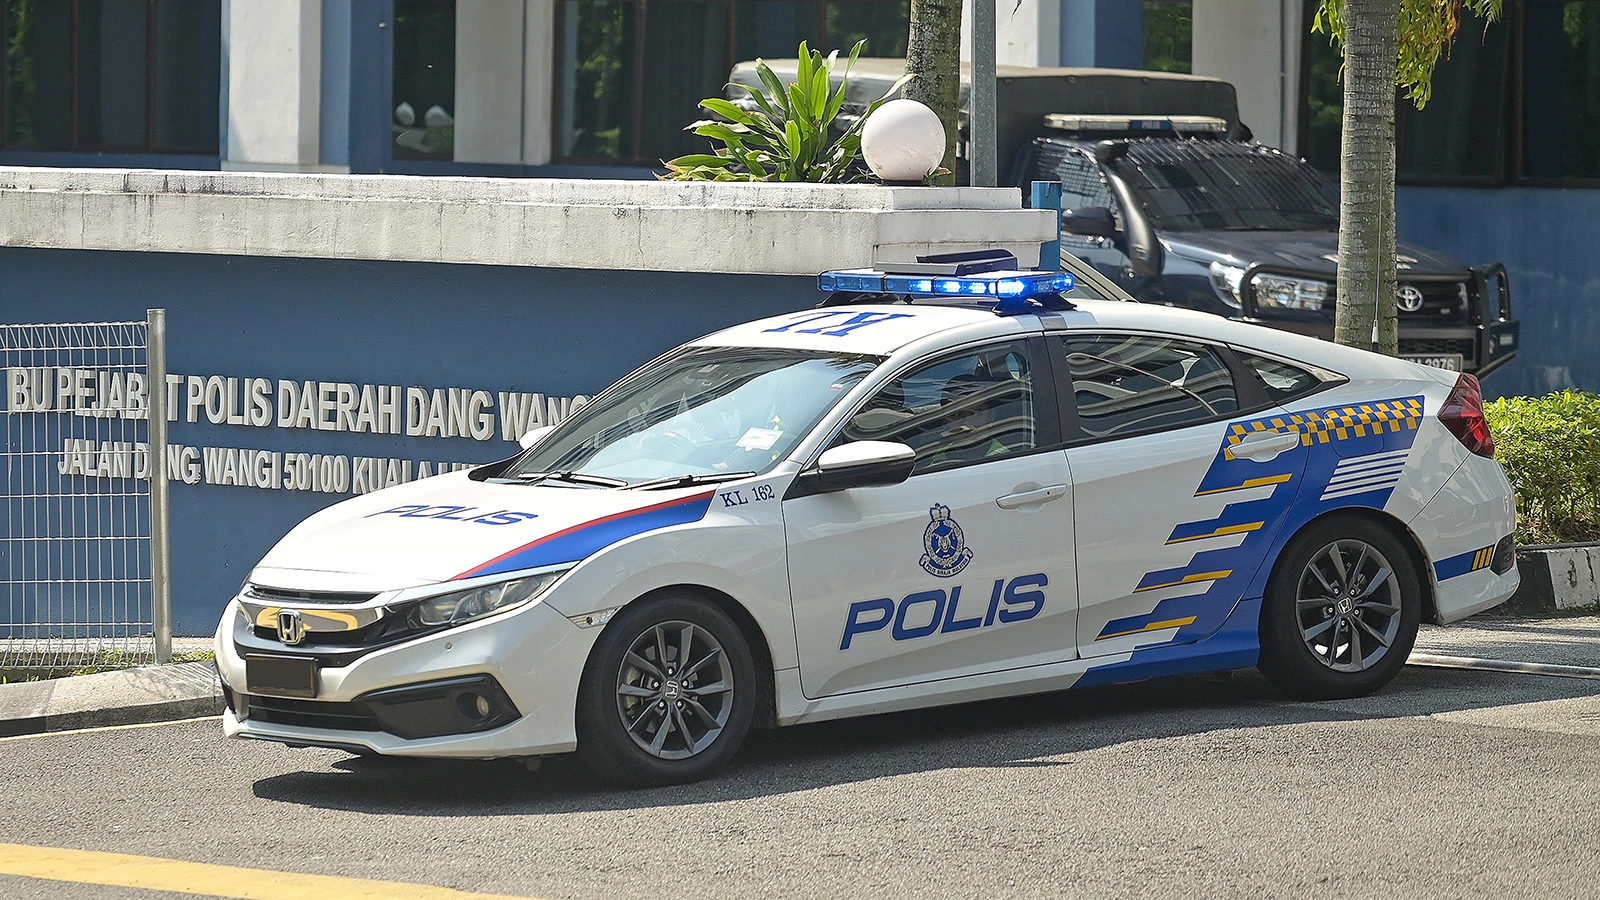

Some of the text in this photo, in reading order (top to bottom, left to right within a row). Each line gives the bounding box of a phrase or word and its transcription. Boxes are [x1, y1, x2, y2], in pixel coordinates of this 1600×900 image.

[9, 367, 52, 414] BU
[57, 367, 184, 422] PEJABT
[187, 375, 273, 427] POLIS
[278, 379, 401, 433] DAERAH
[406, 386, 495, 441] DANG
[58, 438, 131, 479] JALAN
[134, 442, 201, 485] DNG
[203, 447, 281, 489] WANGI
[284, 452, 348, 493] 50100
[363, 504, 539, 525] POLIS
[720, 484, 775, 507] KL 162
[839, 572, 1049, 651] POLIS
